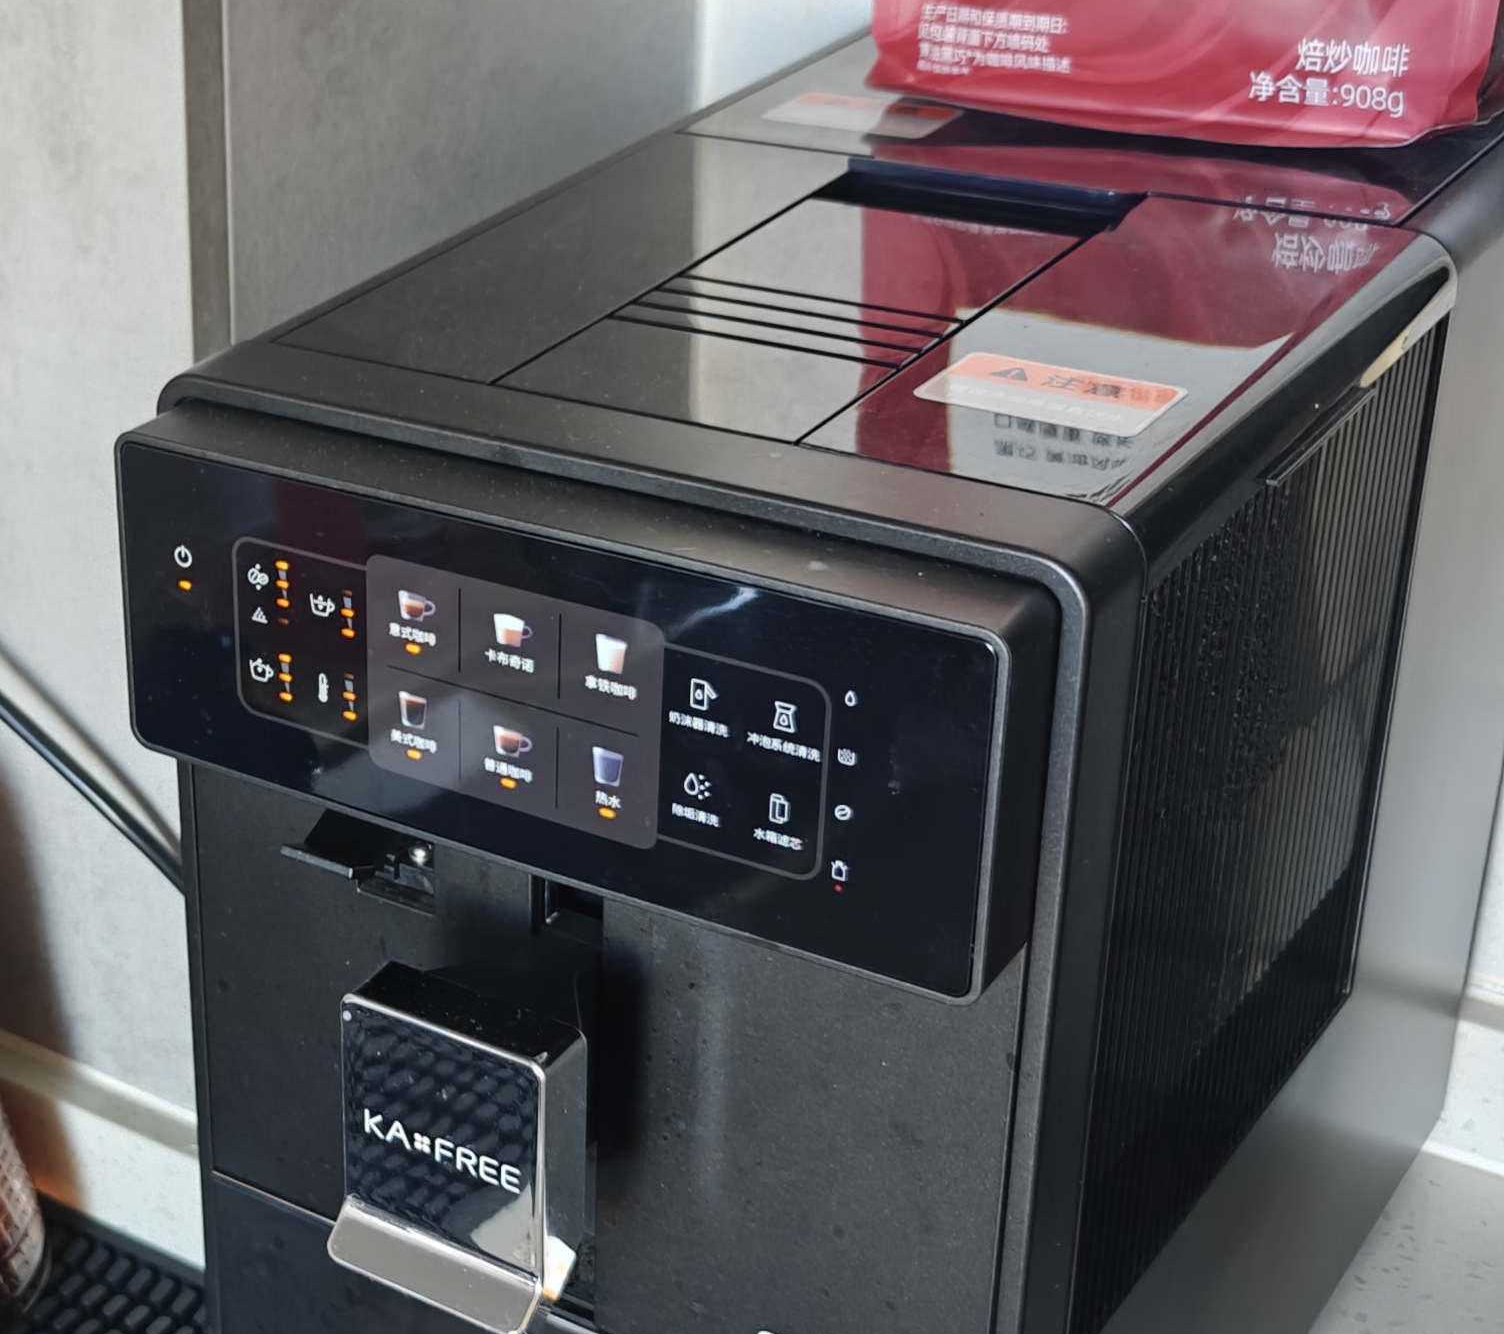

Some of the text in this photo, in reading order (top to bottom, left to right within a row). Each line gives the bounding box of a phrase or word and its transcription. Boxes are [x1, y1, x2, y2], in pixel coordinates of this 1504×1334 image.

[1295, 38, 1411, 78] 焙炒咖啡
[484, 648, 535, 673] 卡布奇诺
[585, 675, 638, 700] 拿铁咖啡
[595, 790, 622, 809] 热水
